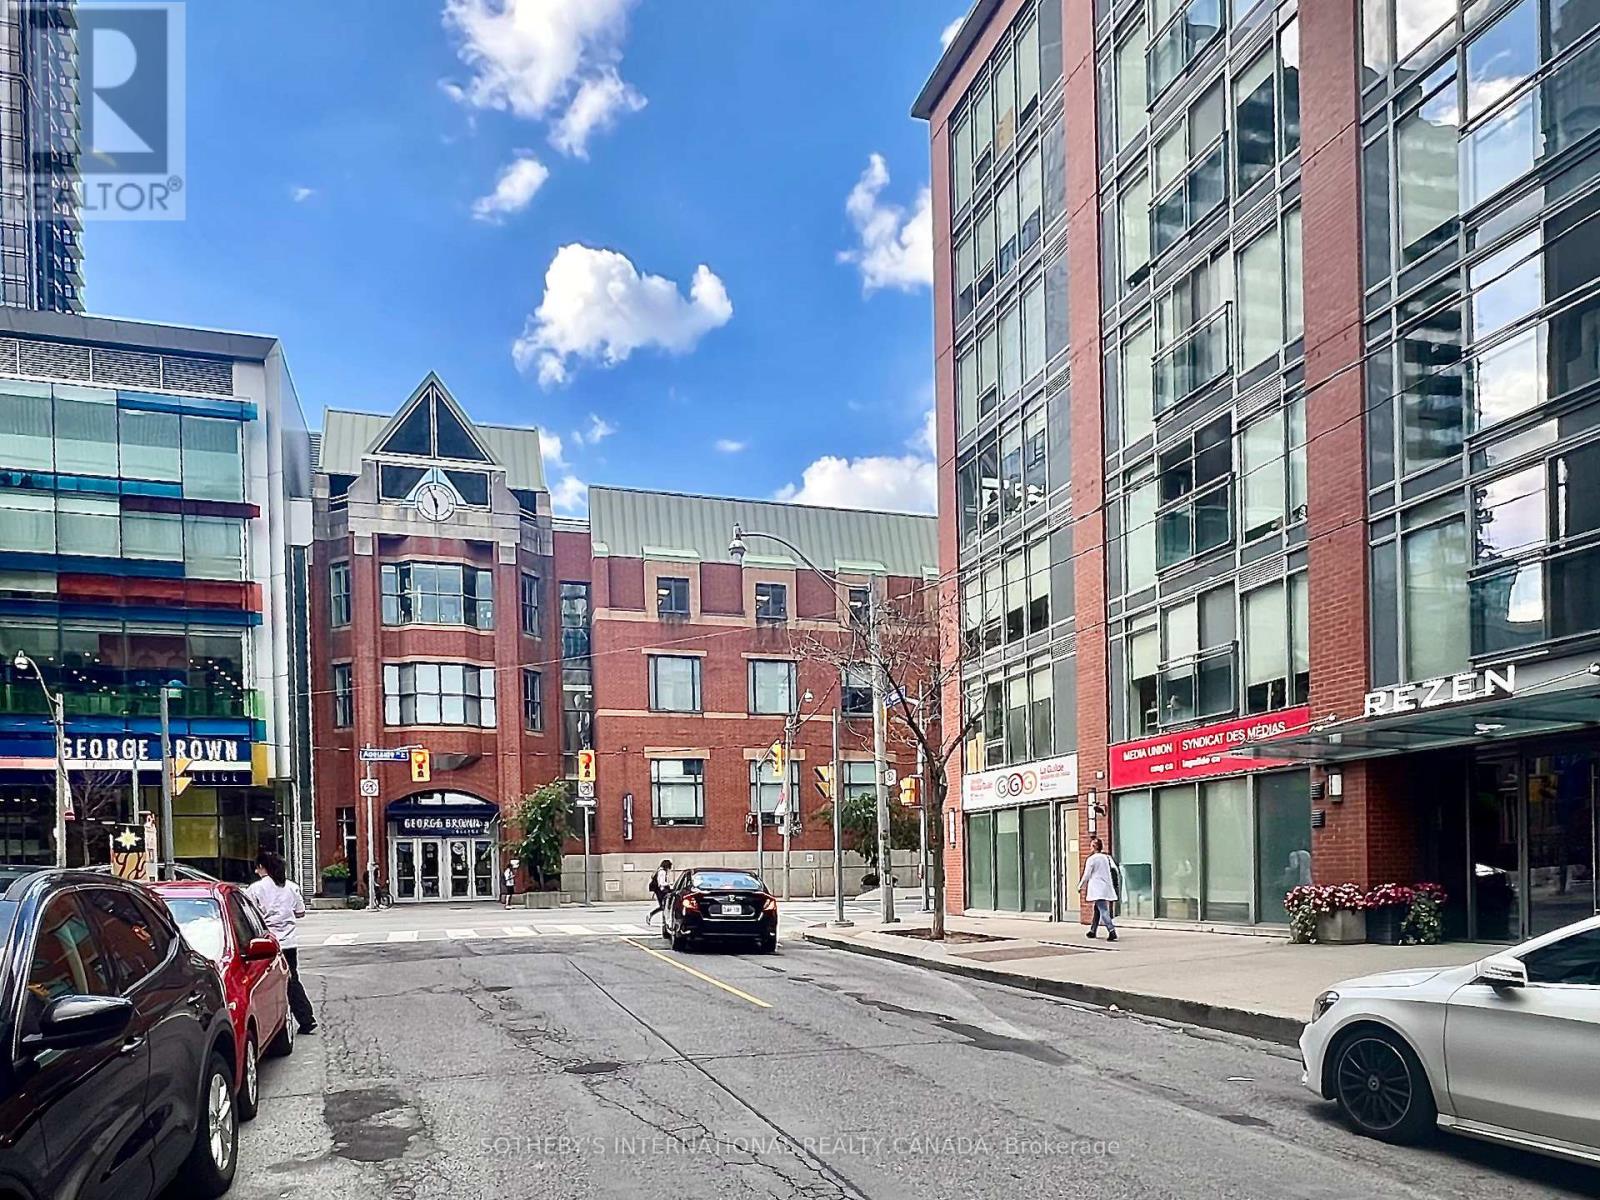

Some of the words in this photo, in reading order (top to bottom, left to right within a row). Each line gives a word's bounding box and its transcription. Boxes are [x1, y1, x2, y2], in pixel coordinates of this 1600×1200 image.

[1363, 664, 1516, 718] REZEN
[62, 738, 149, 760] GEORGE
[1123, 748, 1147, 761] MEDIA
[1147, 743, 1173, 757] UNION
[1182, 733, 1225, 750] SYNDICAT
[1226, 730, 1246, 743] DES
[1246, 722, 1286, 741] MÉDIAS
[404, 818, 443, 829] GEORGE
